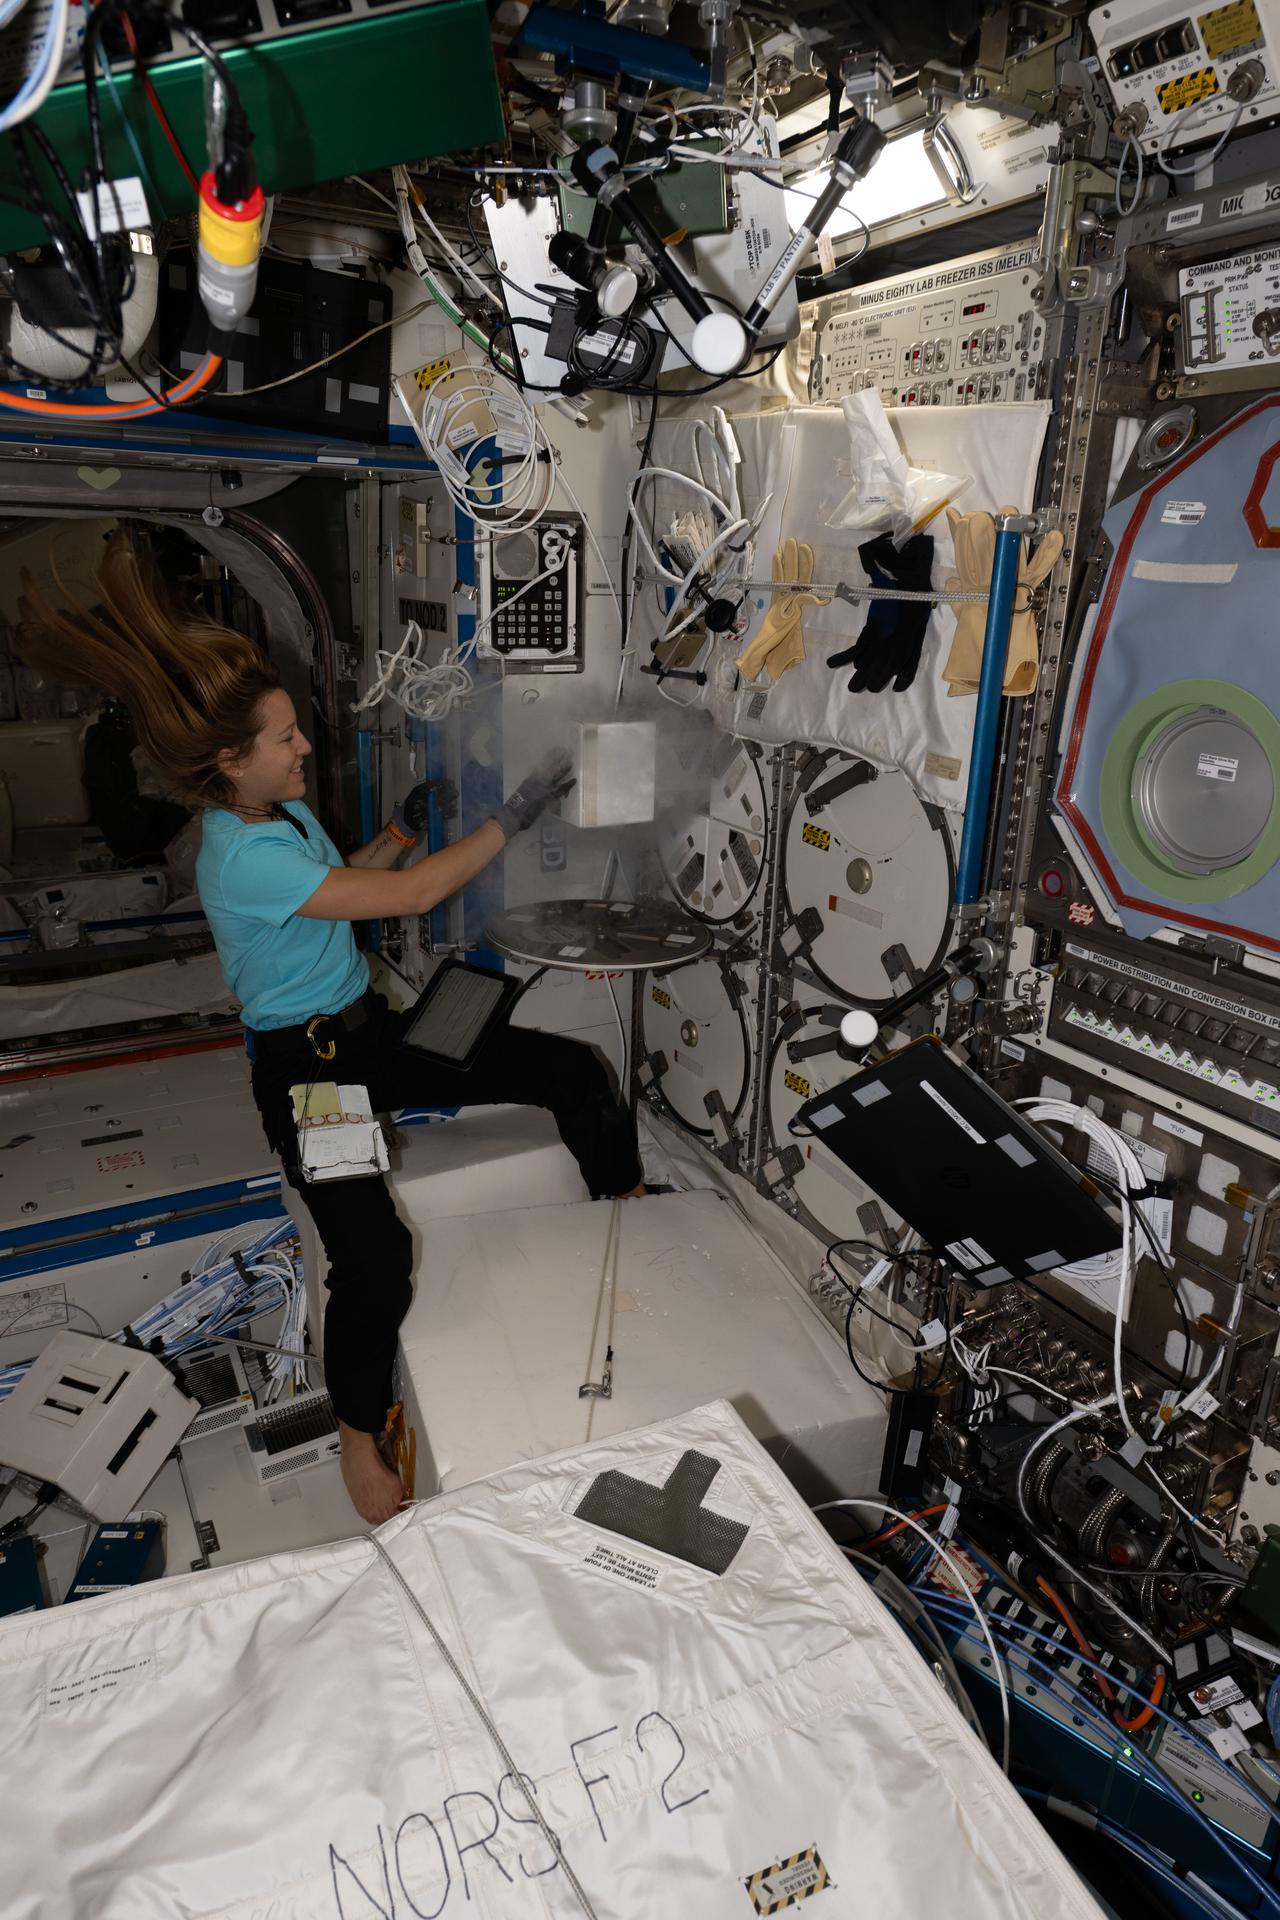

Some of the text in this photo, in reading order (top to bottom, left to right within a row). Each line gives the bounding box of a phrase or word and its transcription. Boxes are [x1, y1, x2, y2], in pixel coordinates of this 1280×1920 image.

[761, 281, 774, 299] LAB
[780, 232, 805, 269] PANTRY
[1188, 261, 1231, 277] COMMAND
[1234, 256, 1252, 267] AND
[860, 252, 1032, 306] MINUS EIGHTY LAB FREEZER ISS (MELFI)
[1229, 283, 1248, 293] STATUS
[865, 311, 893, 323] ELECTRONIC
[400, 600, 447, 632] TO NOD 2
[1093, 954, 1119, 968] POWER
[1120, 964, 1172, 988] DISTRIBUTION
[1173, 984, 1190, 995] AND
[1192, 990, 1247, 1015] CONVERSION
[1248, 1010, 1268, 1022] BOX
[1176, 1062, 1193, 1072] AIRLOCK
[591, 1552, 607, 1561] LEFT
[596, 1546, 615, 1556] TIMES
[584, 1557, 601, 1567] FOUR
[946, 1545, 971, 1571] EMERGENCY
[612, 1568, 626, 1577] ONE
[617, 1563, 635, 1573] MUST
[637, 1564, 658, 1575] CLEAR
[626, 1575, 647, 1585] LEAST
[635, 1570, 655, 1581] VENTS
[330, 1773, 561, 1920] NORS
[784, 1872, 817, 1894] WARNING
